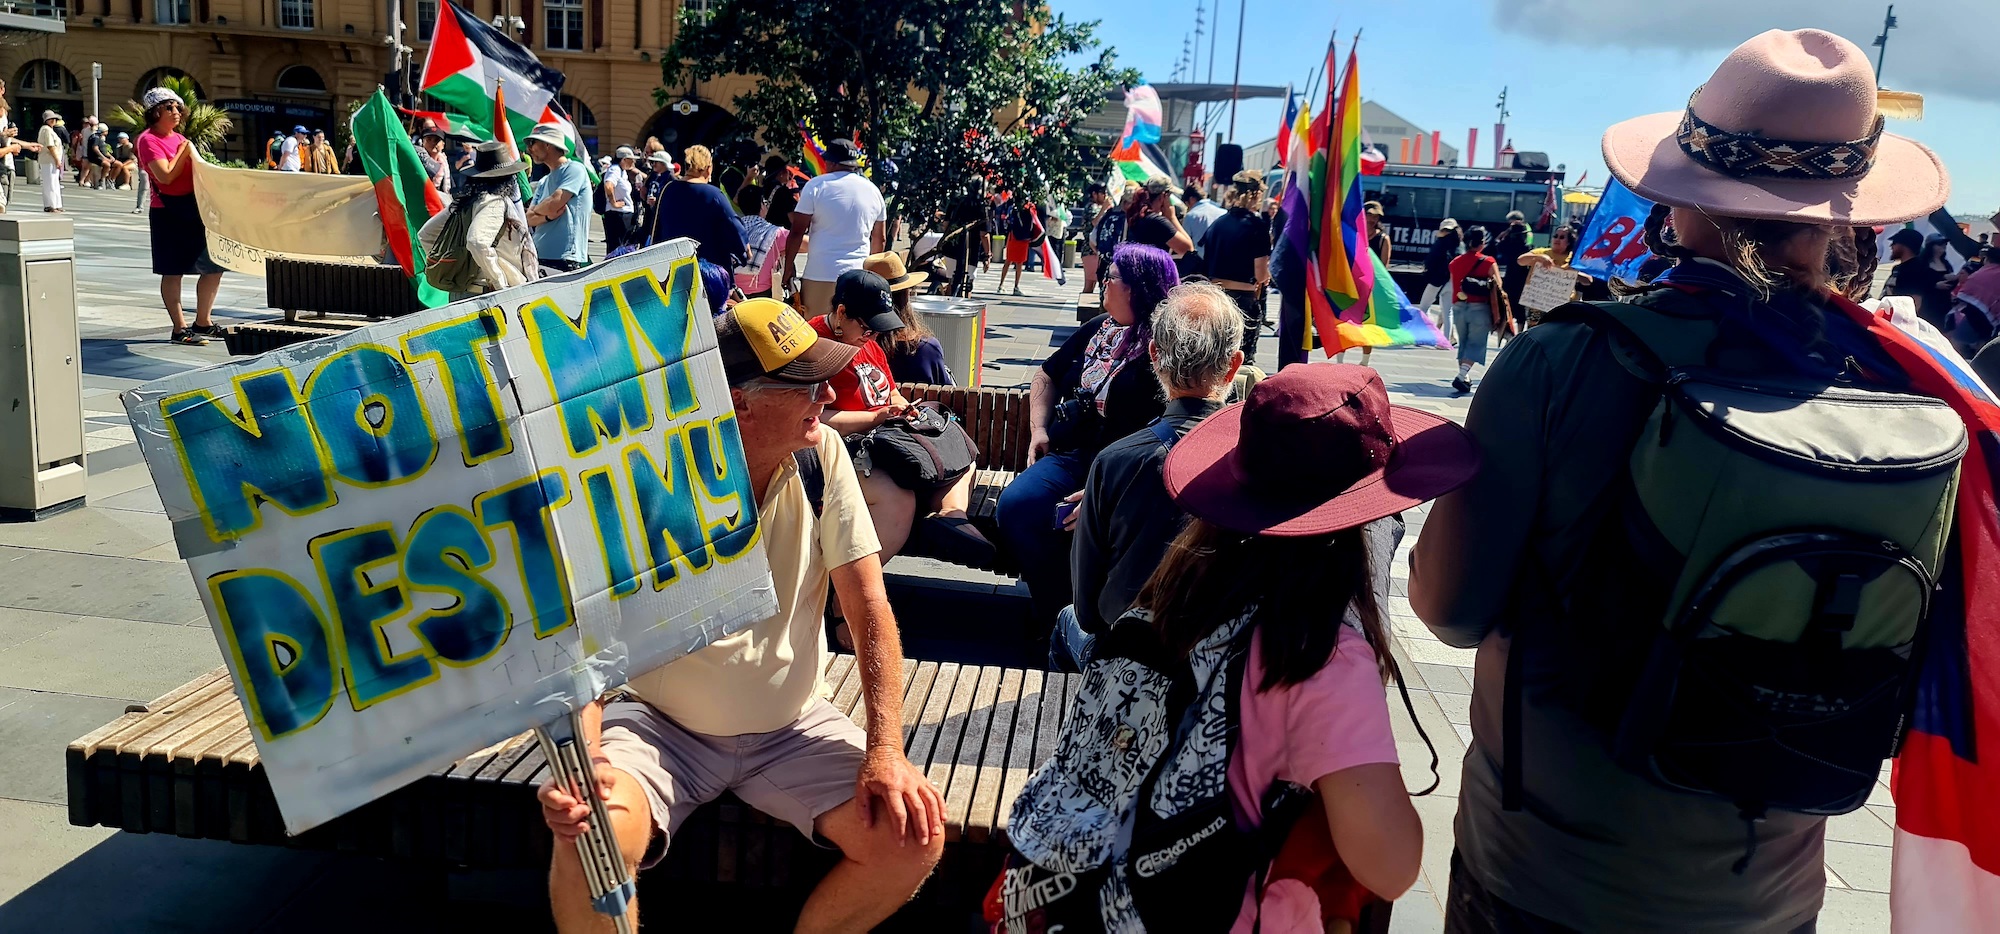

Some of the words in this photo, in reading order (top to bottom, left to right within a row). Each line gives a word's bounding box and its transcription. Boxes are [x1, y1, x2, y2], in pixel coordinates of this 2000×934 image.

[224, 102, 275, 113] HARBOURSIDE
[1393, 226, 1409, 243] TE
[159, 306, 513, 543] NOT
[517, 257, 700, 458] MY
[206, 410, 760, 742] DESTINY
[1753, 684, 1849, 712] TITAN
